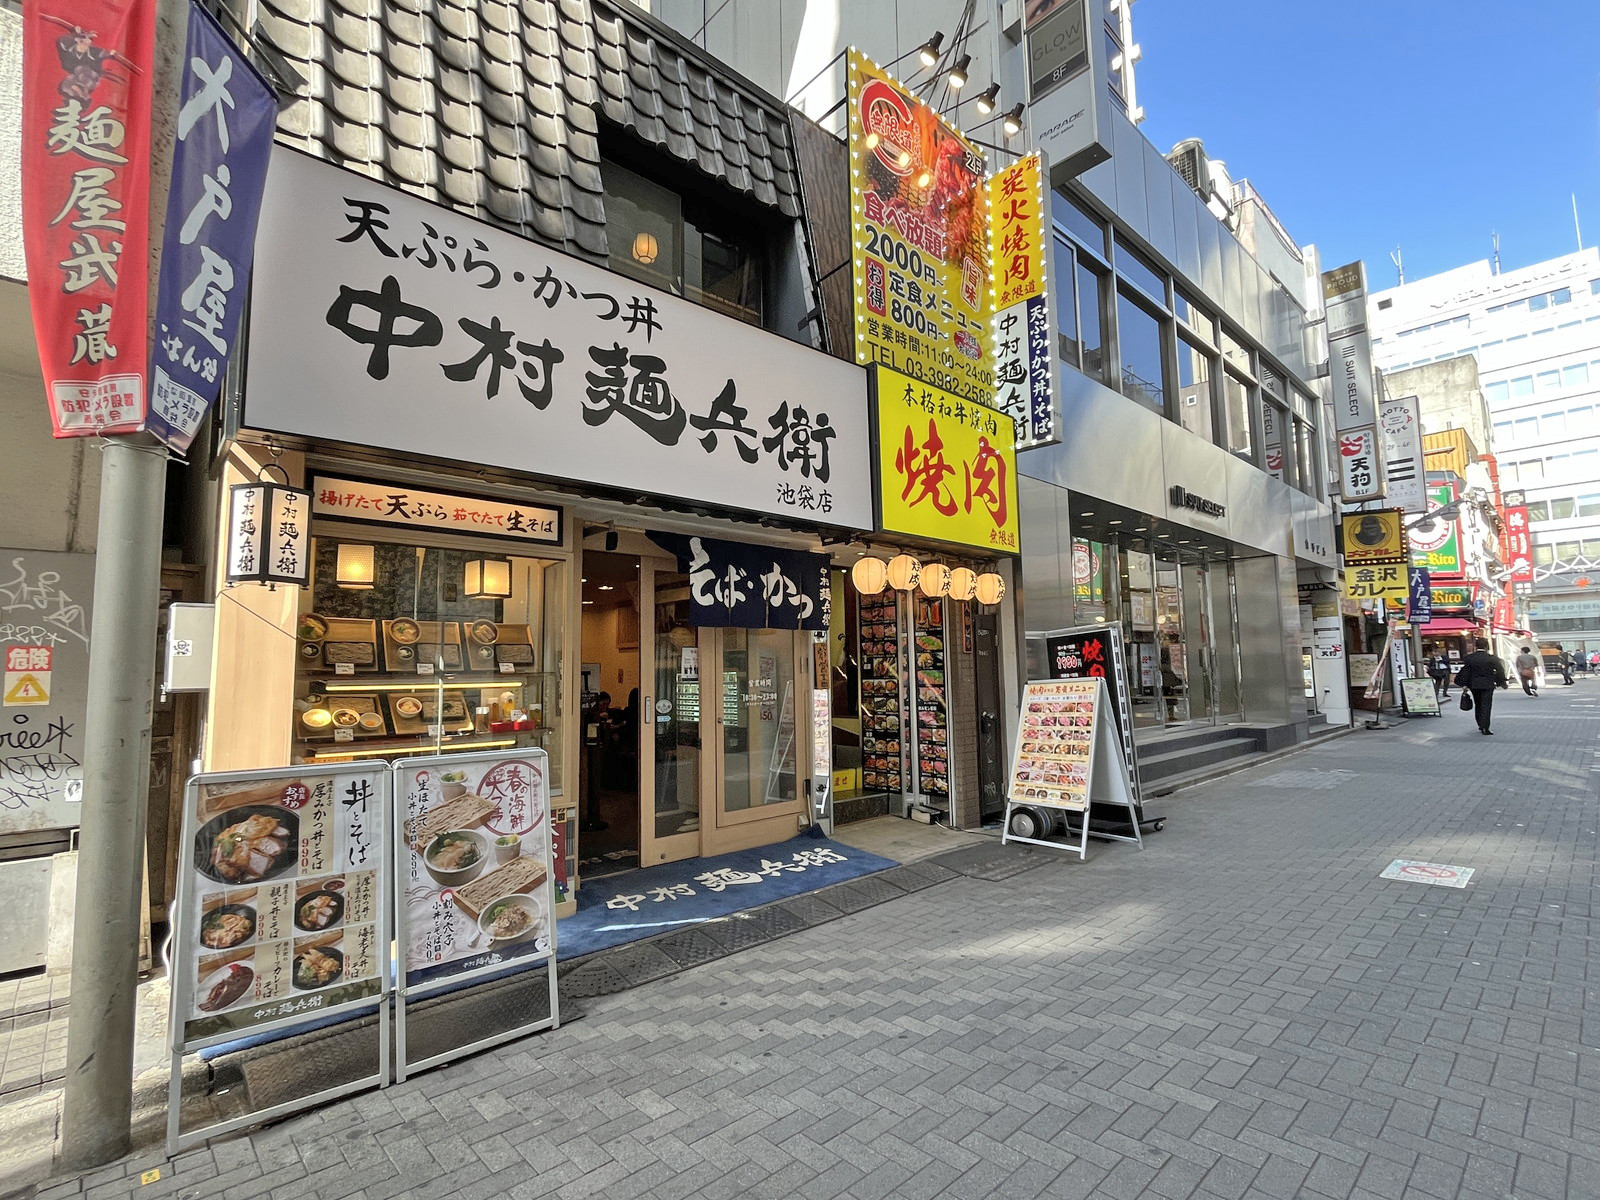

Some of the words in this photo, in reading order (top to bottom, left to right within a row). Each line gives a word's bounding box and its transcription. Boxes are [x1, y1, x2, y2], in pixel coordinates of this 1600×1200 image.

[1033, 20, 1080, 61] GLOW
[1052, 63, 1067, 82] 8F
[965, 151, 982, 175] 2F
[1026, 158, 1038, 171] 2F
[177, 55, 236, 357] 大戸屋
[863, 190, 944, 262] 食べ放題
[999, 167, 1031, 286] 炭火焼肉
[335, 195, 663, 344] 天ぷら・かつ丼
[867, 261, 884, 311] お得
[1326, 274, 1358, 290] PROUD
[888, 270, 982, 331] 定食メニュー
[325, 274, 838, 484] 中村麺兵衛
[1344, 359, 1356, 380] SUIT
[902, 383, 998, 436] 本格和牛焼肉
[1347, 382, 1360, 418] SELECT
[1380, 406, 1410, 419] MOTTO
[1385, 425, 1408, 435] CAFE
[895, 417, 1008, 529] 焼肉
[1350, 456, 1371, 488] 天狗
[319, 489, 448, 521] 揚げたて天ぷら
[452, 507, 554, 533] 茹でたて生そば
[775, 481, 834, 514] 池袋店
[236, 490, 256, 573] 中村麺兵衛
[276, 490, 299, 574] 中村麺兵衛
[989, 530, 1016, 548] 無限道
[689, 537, 814, 620] そば・かつ
[1355, 567, 1397, 583] 金沢
[1428, 552, 1456, 565] Rico
[1349, 583, 1406, 597] カレー
[1410, 569, 1431, 609] 大戸屋
[1432, 590, 1462, 603] Rico
[8, 648, 50, 671] 危険
[282, 786, 299, 809] おすすめ
[418, 779, 429, 827] 生ほたて
[504, 765, 530, 832] 春の海鮮
[310, 782, 326, 871] 厚みかつ丼とそば
[342, 779, 374, 866] 丼とそば
[605, 847, 849, 911] 中村麺兵衛
[269, 886, 281, 939] 親子丼とそば
[442, 898, 454, 946] 刻み穴子
